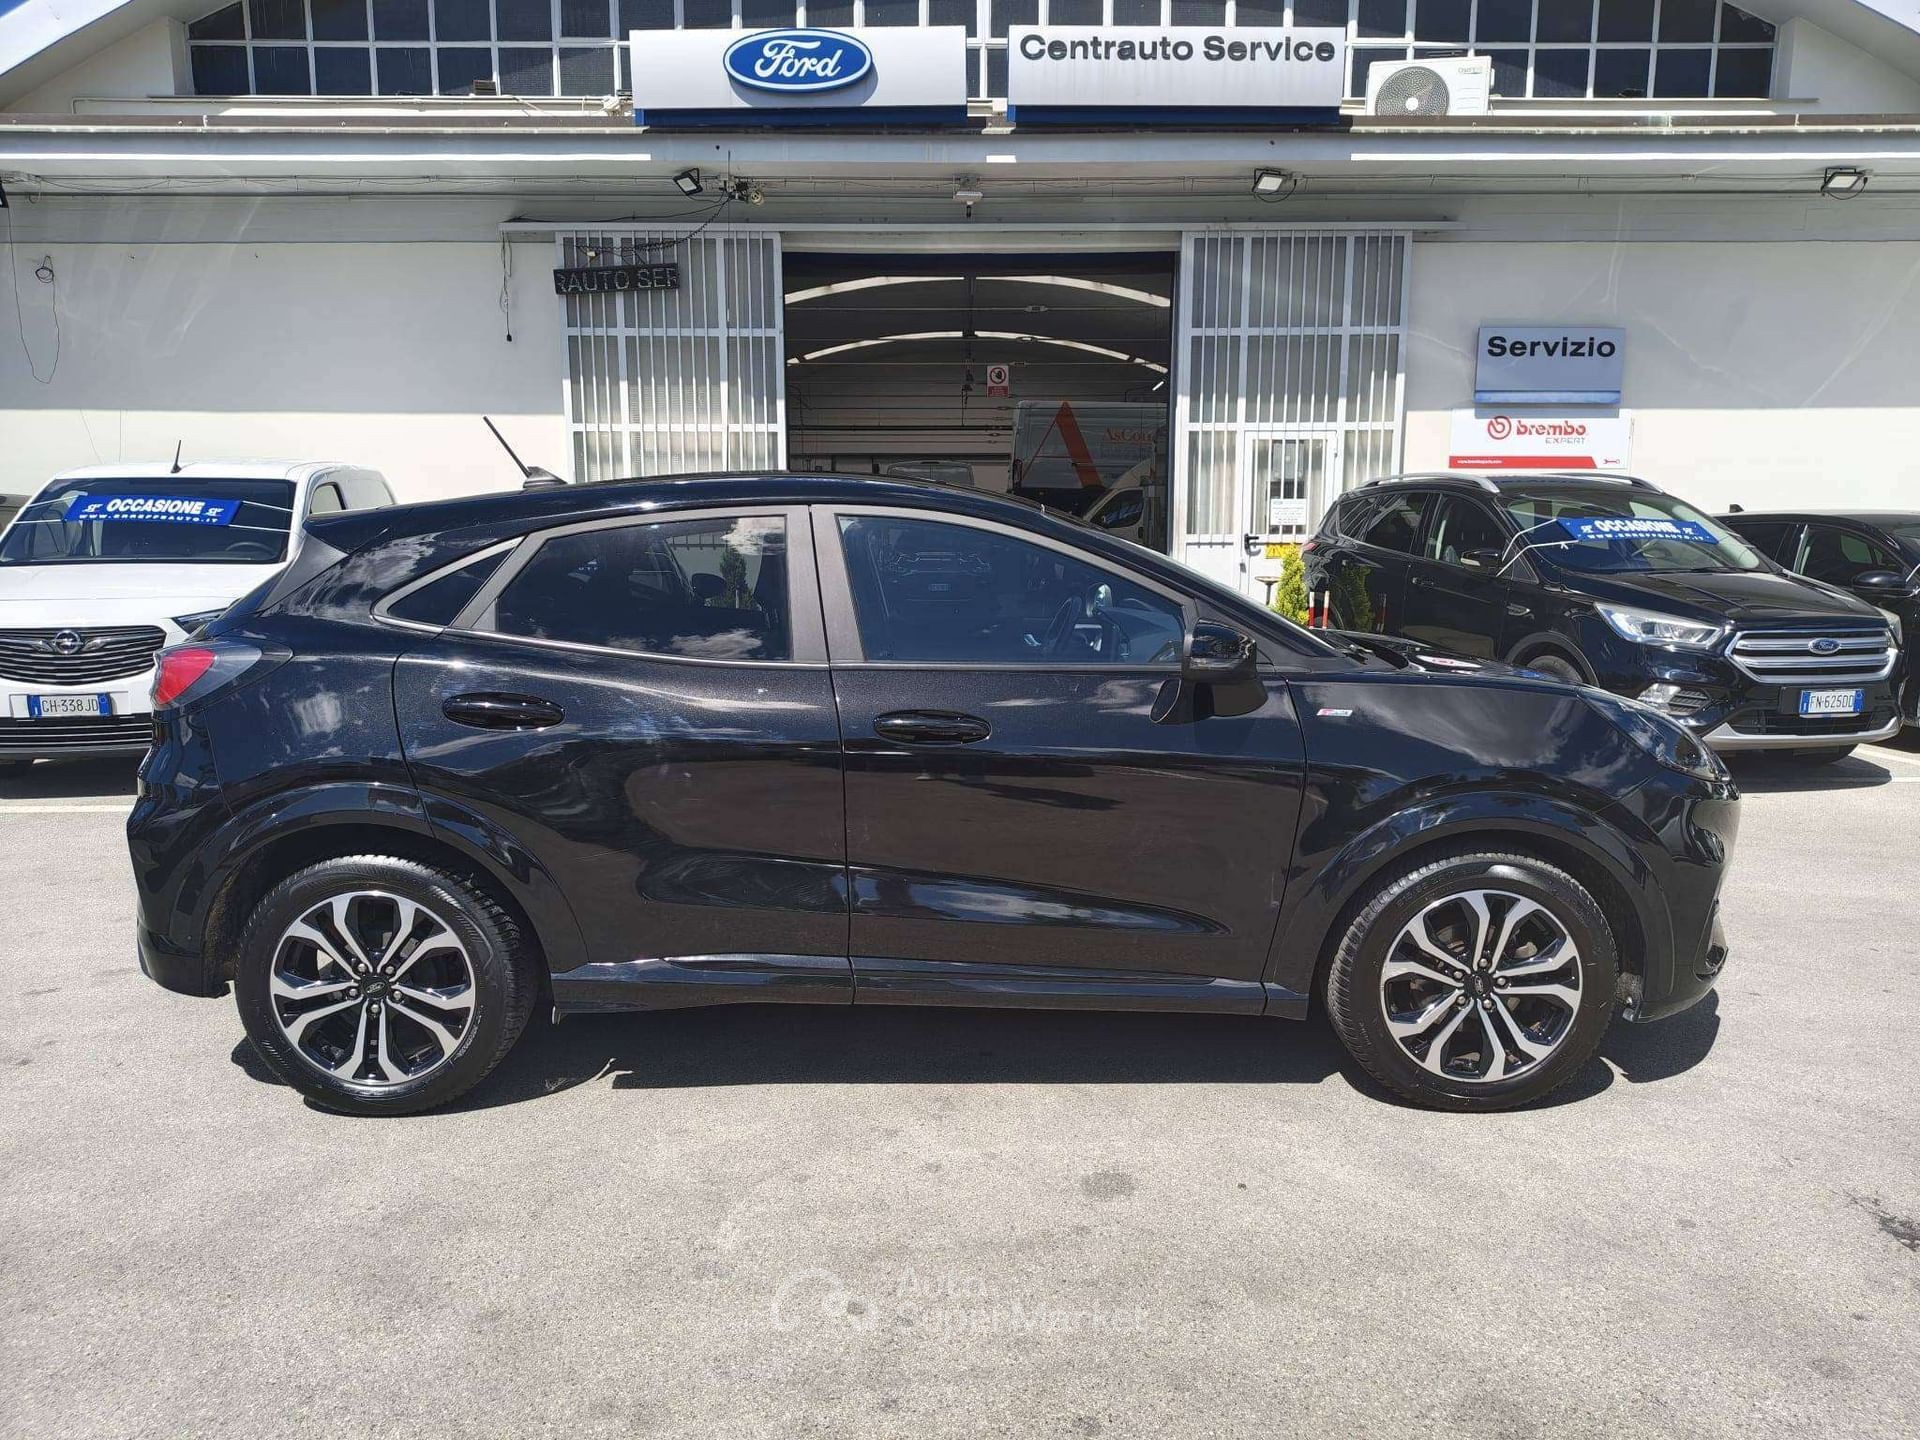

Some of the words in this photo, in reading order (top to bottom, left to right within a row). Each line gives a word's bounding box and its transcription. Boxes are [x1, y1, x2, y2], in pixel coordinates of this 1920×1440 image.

[1020, 34, 1194, 61] Centrauto
[1203, 35, 1336, 62] Service
[754, 39, 843, 78] Ford
[1487, 336, 1616, 358] Servizio
[1516, 420, 1587, 436] brembo
[106, 498, 206, 515] OCCASIONE
[1594, 519, 1681, 533] OCCASIONE
